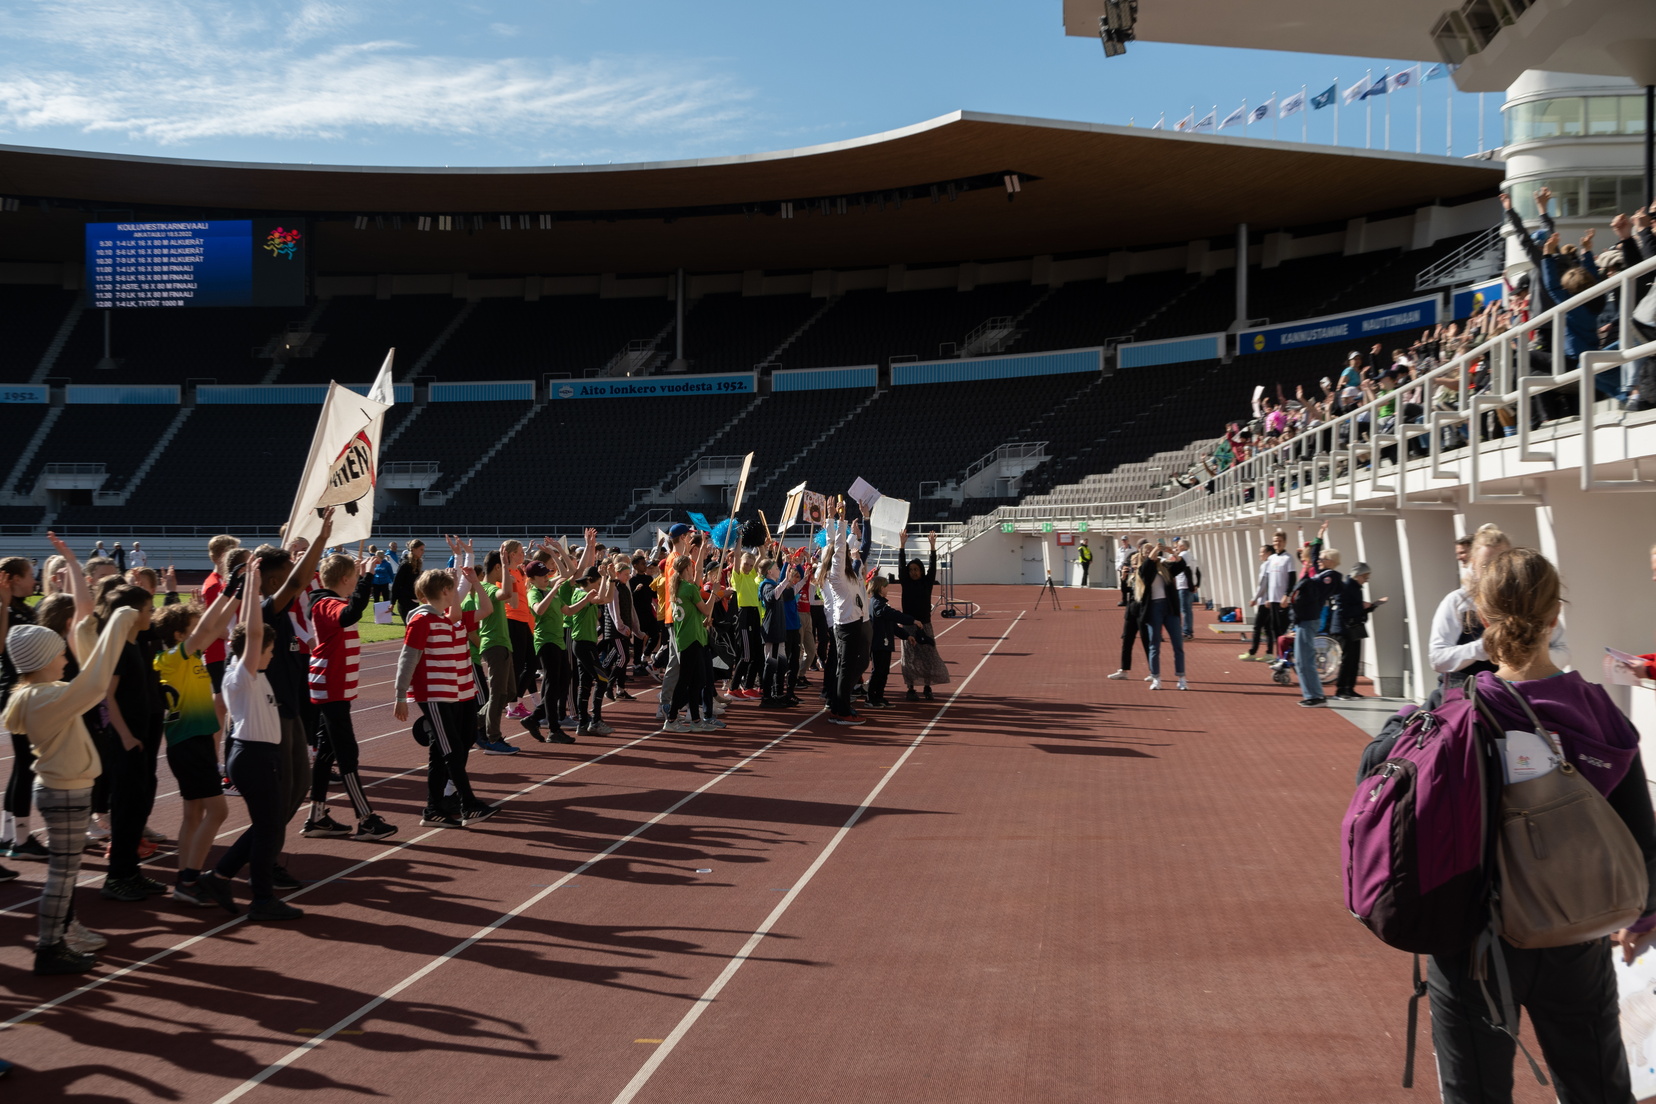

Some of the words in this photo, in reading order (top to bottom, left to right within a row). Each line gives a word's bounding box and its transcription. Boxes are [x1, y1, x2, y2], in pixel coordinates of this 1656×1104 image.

[117, 223, 208, 231] KOULUVIESTIKARNEVAALI
[1280, 324, 1349, 345] KANNUSTAMME
[1361, 310, 1421, 332] NAUTTIMAAN
[580, 386, 606, 396] Aito
[610, 384, 656, 394] lonkero
[660, 382, 712, 393] vuodesta
[716, 381, 748, 392] 1952.
